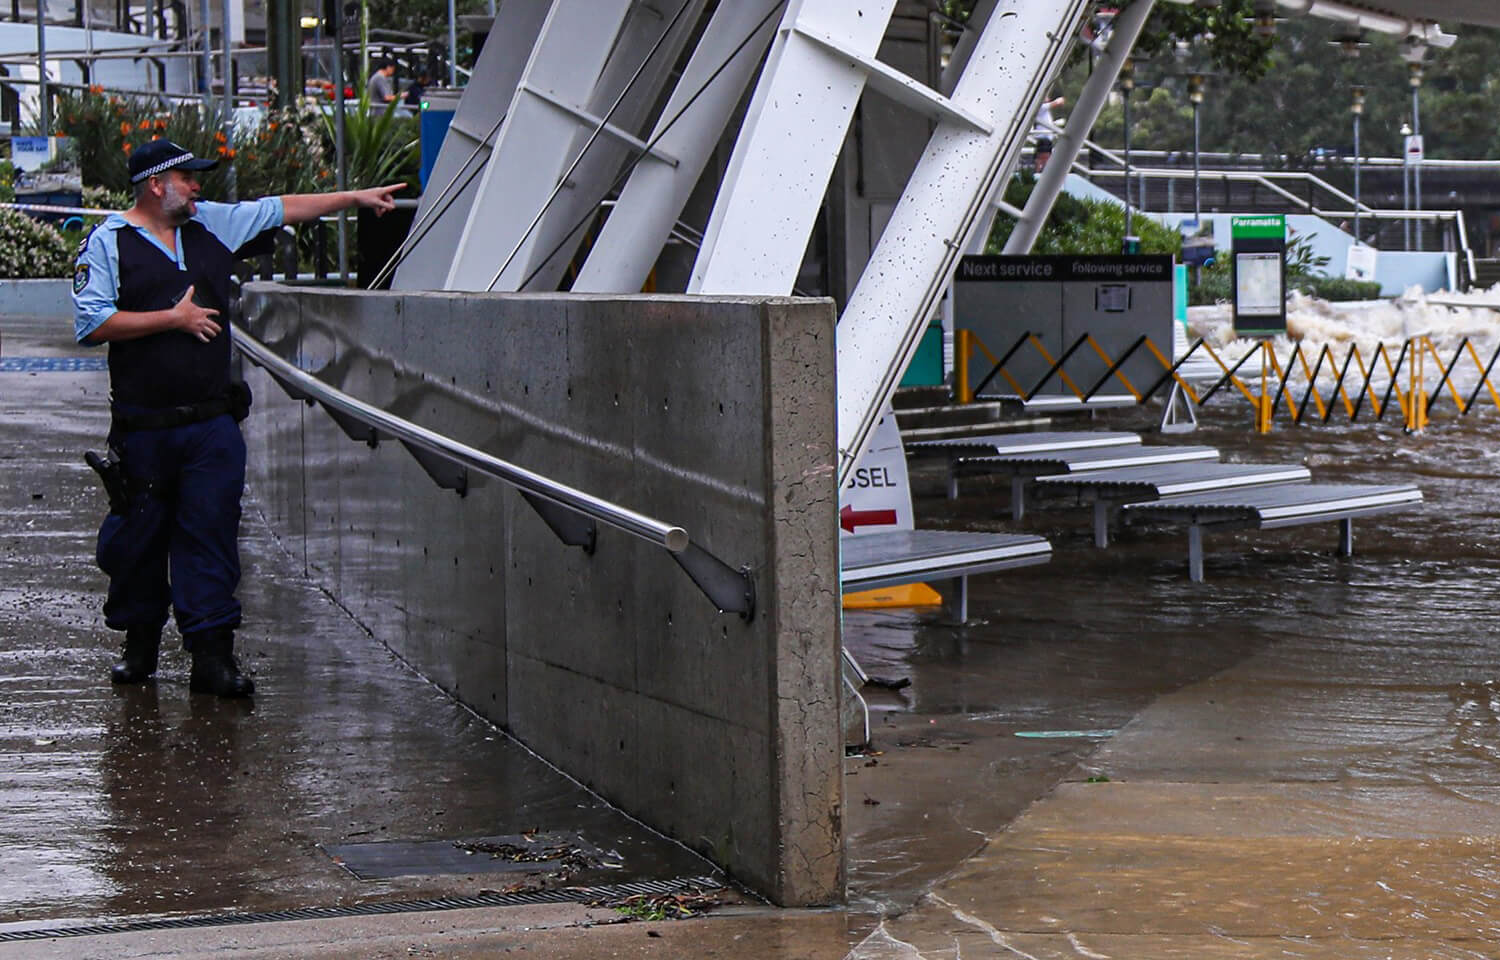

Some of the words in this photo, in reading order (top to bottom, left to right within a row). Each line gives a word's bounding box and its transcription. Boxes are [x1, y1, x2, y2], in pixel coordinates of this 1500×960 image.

[963, 261, 997, 276] Next
[1001, 262, 1053, 276] service
[1072, 261, 1122, 275] Following
[1125, 263, 1163, 274] service
